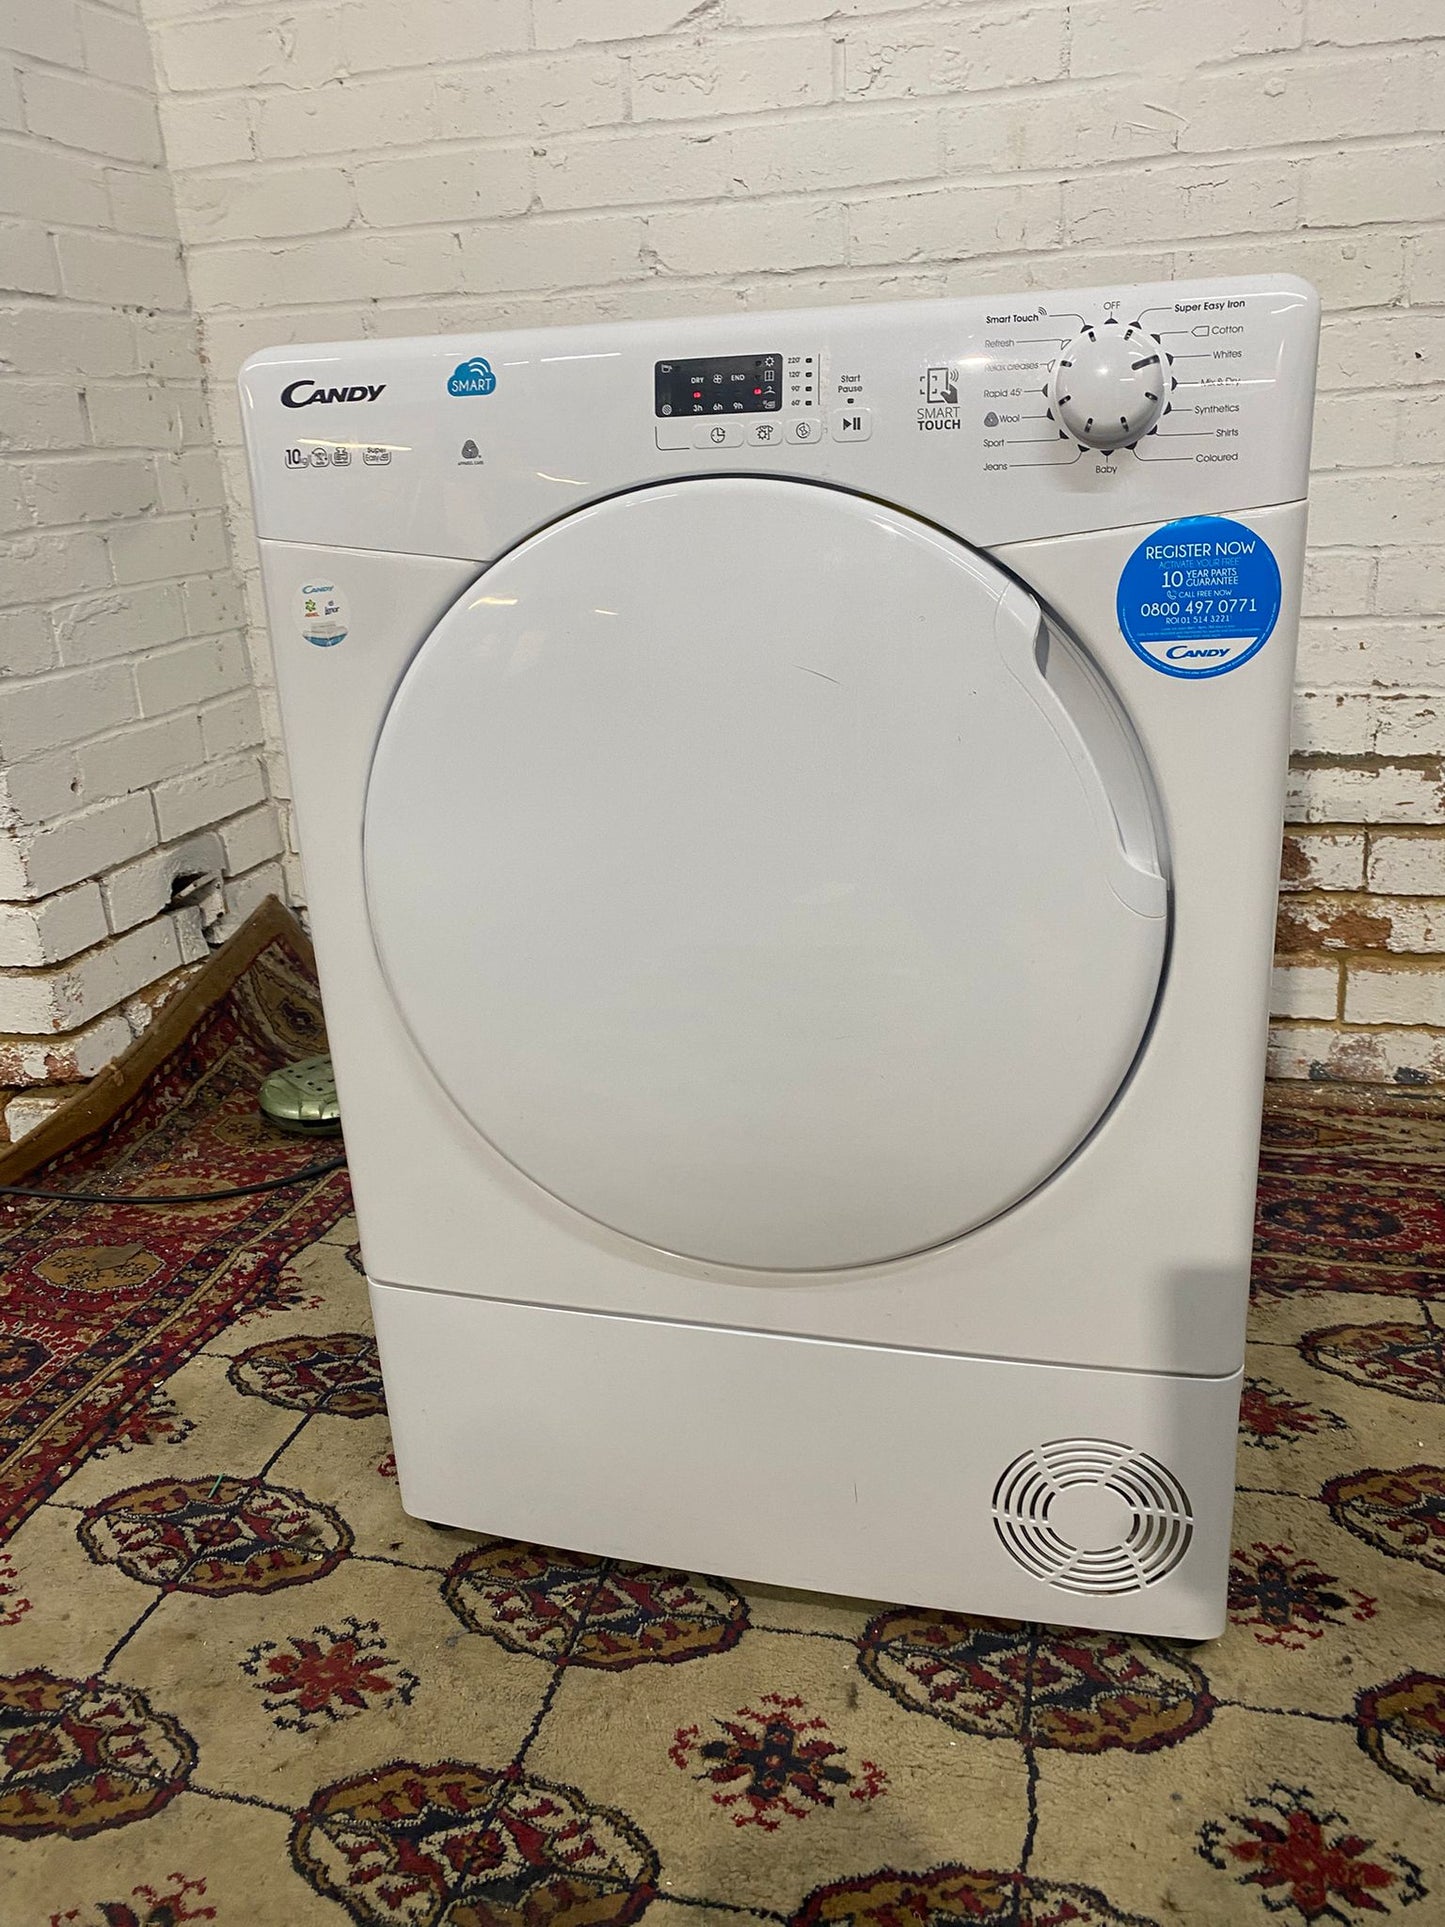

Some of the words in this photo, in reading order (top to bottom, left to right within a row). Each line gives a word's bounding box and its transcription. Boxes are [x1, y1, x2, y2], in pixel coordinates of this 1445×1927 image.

[1103, 301, 1121, 310] OFF
[1174, 303, 1202, 313] Super
[1203, 302, 1225, 310] Easy
[1227, 300, 1246, 308] Iron
[985, 315, 1011, 324] Smart
[1013, 313, 1039, 322] Touch
[1211, 325, 1244, 335] Cotton
[984, 339, 1015, 348] Refresh
[1212, 350, 1242, 359] Whites
[731, 374, 746, 382] END
[840, 374, 861, 383] Start
[452, 378, 492, 393] SMART
[837, 385, 863, 394] Pause
[280, 380, 387, 408] CANDY
[983, 389, 1008, 399] Rapid
[692, 404, 704, 412] 3h
[712, 402, 724, 410] 6h
[732, 402, 744, 410] 9h
[1194, 404, 1240, 415] Synthetics
[917, 407, 961, 420] SMART
[999, 414, 1021, 423] Wool
[917, 419, 961, 431] TOUCH
[1215, 428, 1239, 438] Shirts
[983, 439, 1005, 448] Sport
[1195, 453, 1239, 463] Coloured
[983, 463, 1008, 471] Jeans
[1095, 465, 1118, 475] Baby
[1146, 543, 1211, 559] REGISTER
[1215, 540, 1257, 556] NOW
[1159, 559, 1194, 569] ACTIVATE
[1196, 558, 1220, 567] YOUR
[1161, 570, 1184, 588] 10
[1186, 569, 1209, 579] YEAR
[1211, 567, 1237, 577] PARTS
[1185, 576, 1239, 587] GUARANTEE
[1213, 589, 1233, 597] NOW
[1140, 602, 1180, 617] 0800
[1185, 600, 1213, 615] 497
[1218, 598, 1257, 613] 0771
[1165, 617, 1180, 625] ROI
[1180, 616, 1191, 624] 01
[1193, 615, 1209, 624] 514
[1210, 614, 1231, 623] 3221
[1166, 645, 1231, 660] CANDY
